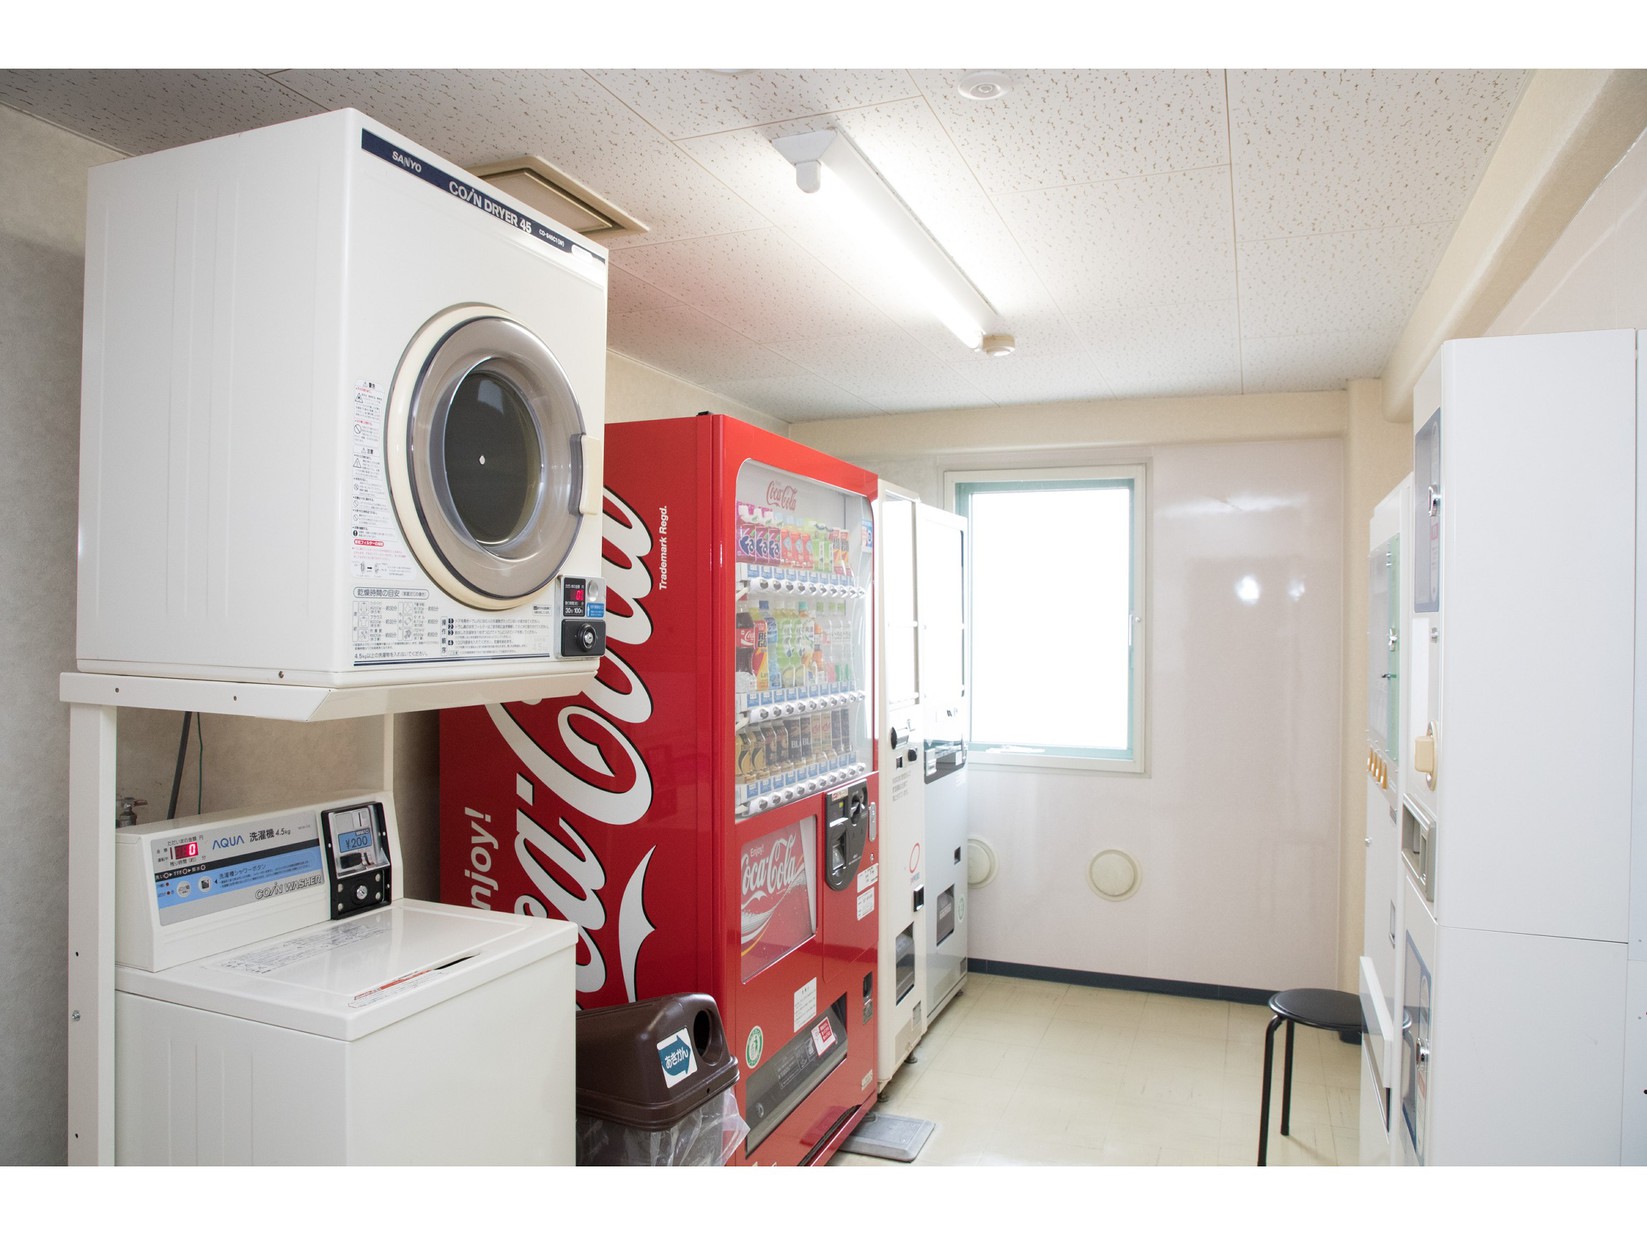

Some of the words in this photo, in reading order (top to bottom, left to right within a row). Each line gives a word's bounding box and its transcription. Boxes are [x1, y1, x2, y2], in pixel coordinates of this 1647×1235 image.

[391, 150, 422, 173] SANYO
[484, 200, 518, 227] DRYER
[519, 217, 532, 235] 45
[658, 505, 669, 535] Regd.
[658, 536, 668, 591] Trademark
[212, 835, 245, 851] AQUA
[249, 828, 275, 844] 洗濯機
[345, 836, 369, 850] ¥200
[189, 843, 196, 856] 0
[464, 807, 498, 910] njoy!
[285, 874, 322, 893] WASHER
[664, 1046, 689, 1069] あきかん
